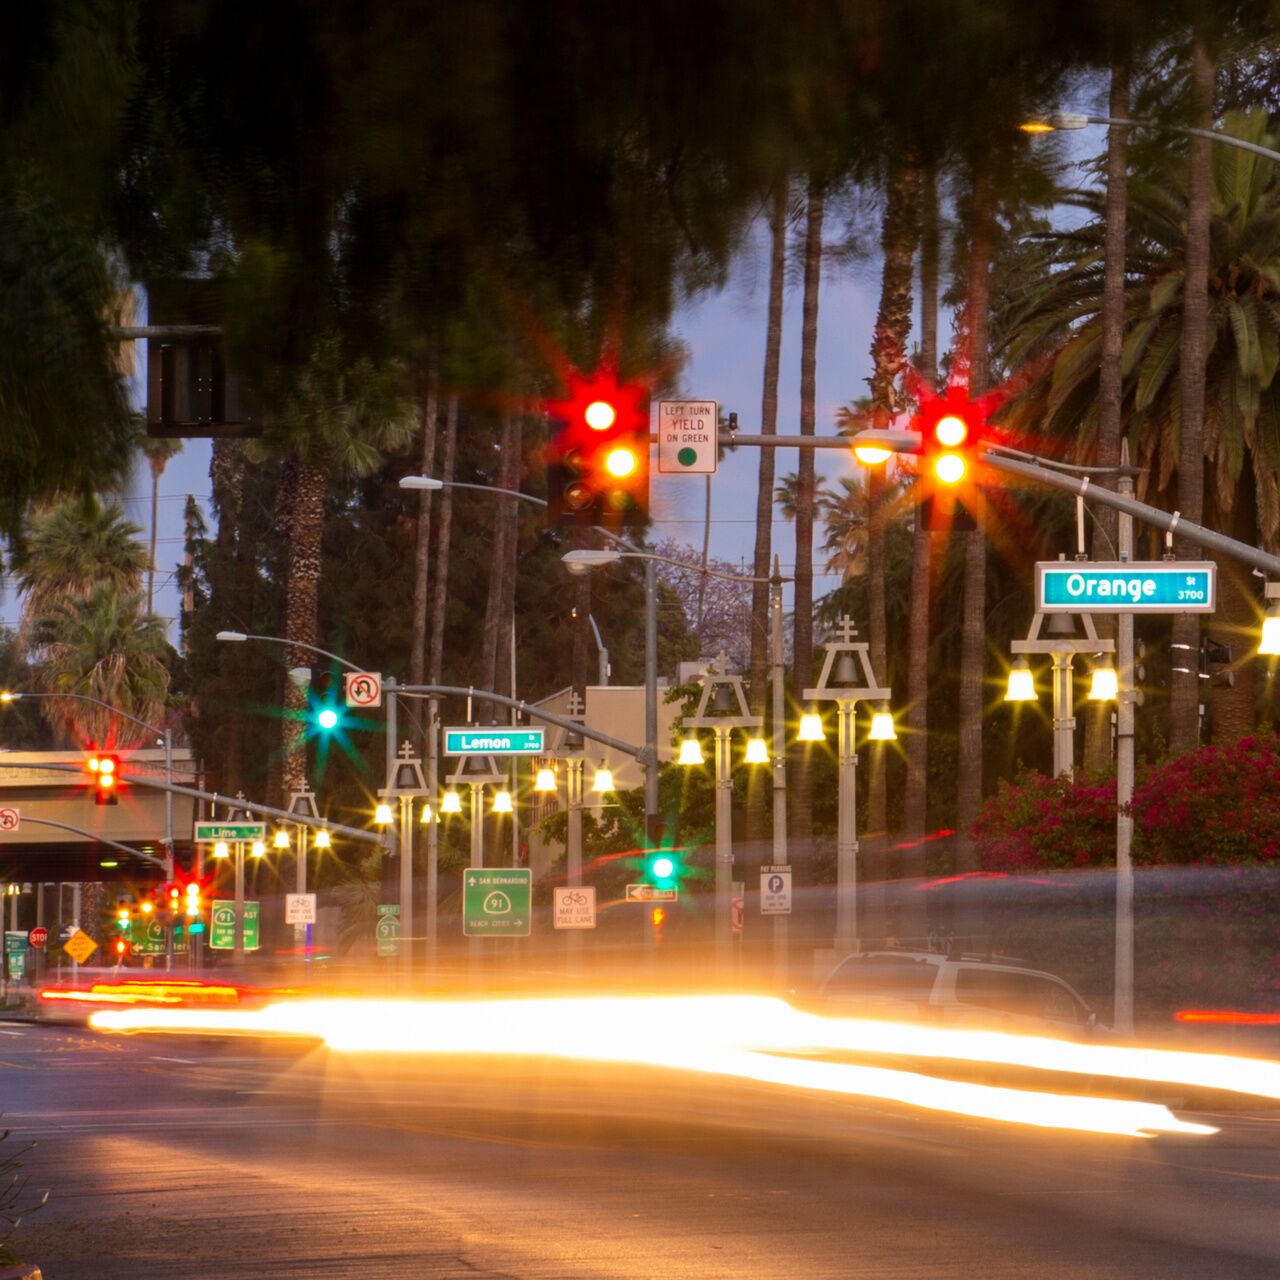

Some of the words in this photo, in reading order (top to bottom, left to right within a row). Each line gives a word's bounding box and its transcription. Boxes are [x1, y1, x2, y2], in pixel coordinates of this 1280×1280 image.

[665, 406, 684, 416] LEFT
[689, 406, 710, 416] TURN
[672, 419, 704, 431] YIELD
[667, 434, 678, 443] ON
[682, 434, 709, 443] GREEN
[1186, 576, 1196, 586] St
[1066, 574, 1157, 602] Orange
[1178, 590, 1204, 600] 3700
[461, 736, 511, 749] Lemon
[211, 828, 237, 838] Lime
[491, 899, 502, 908] 91
[220, 912, 230, 921] 91
[381, 925, 396, 937] 91
